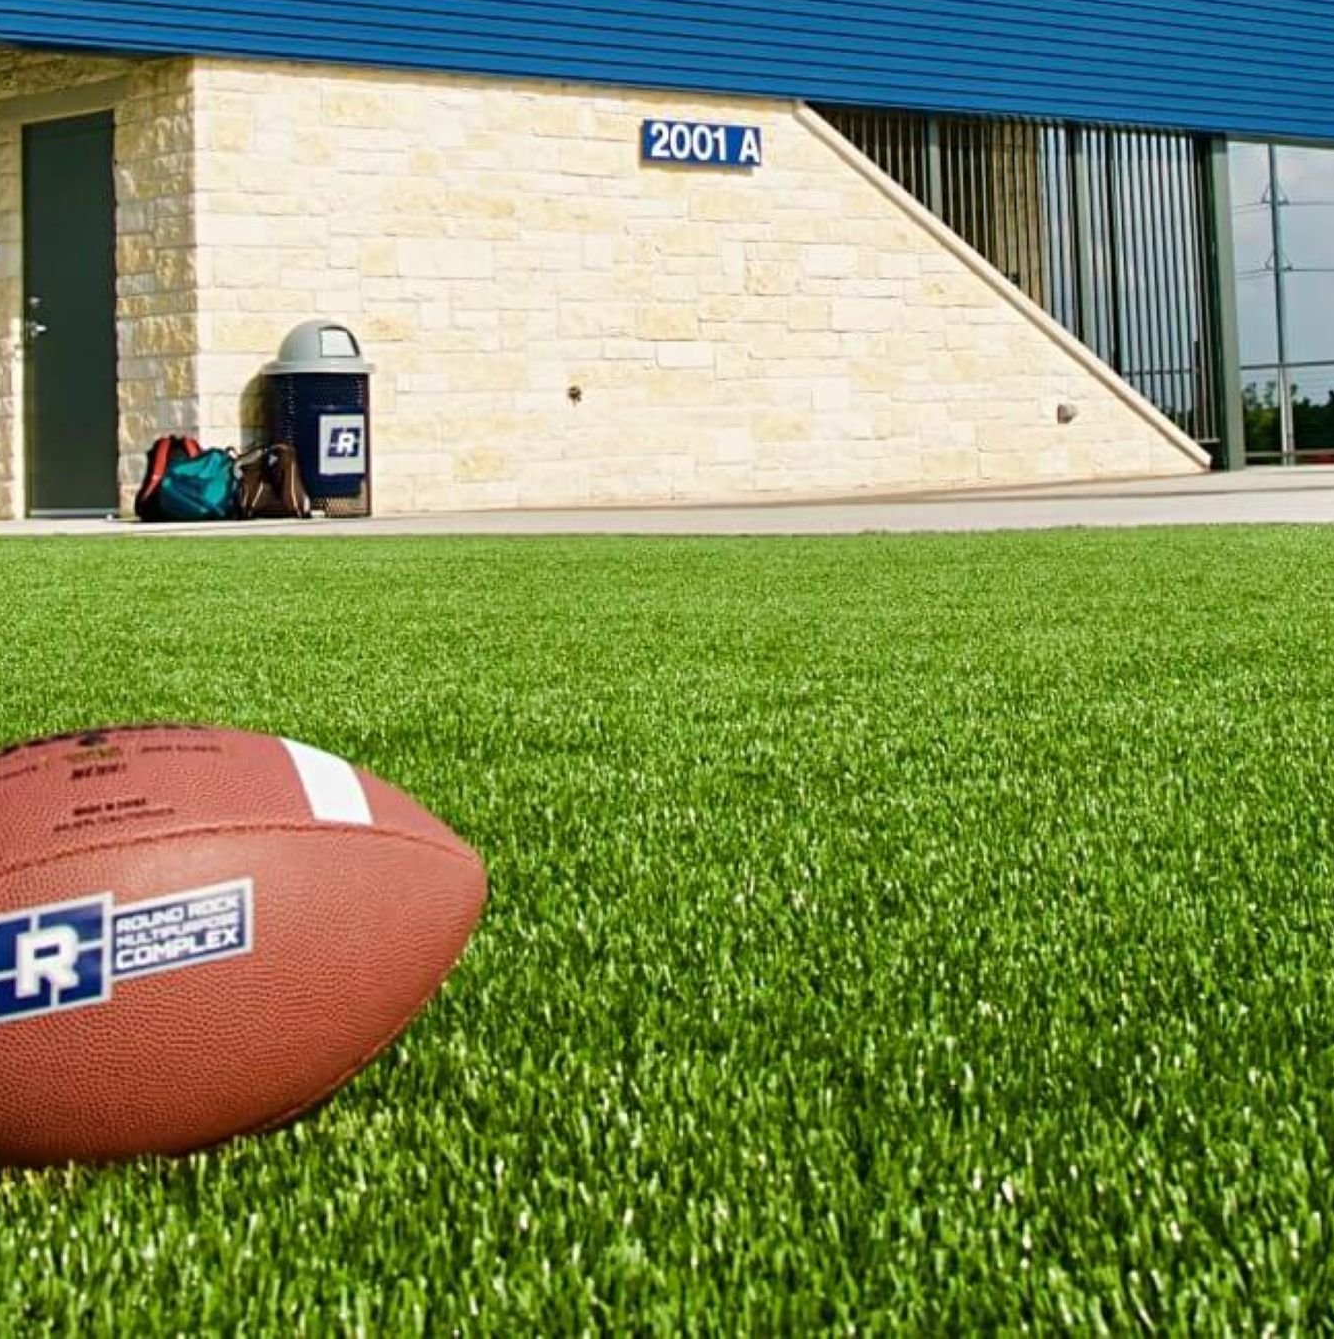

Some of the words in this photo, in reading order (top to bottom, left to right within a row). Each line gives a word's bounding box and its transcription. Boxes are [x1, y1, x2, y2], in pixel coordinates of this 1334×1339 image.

[650, 122, 727, 161] 2001
[738, 128, 760, 163] A
[338, 433, 355, 454] R
[116, 906, 184, 934] ROUND
[187, 894, 240, 919] ROCK
[16, 925, 80, 999] R
[116, 925, 239, 971] COMPLEX
